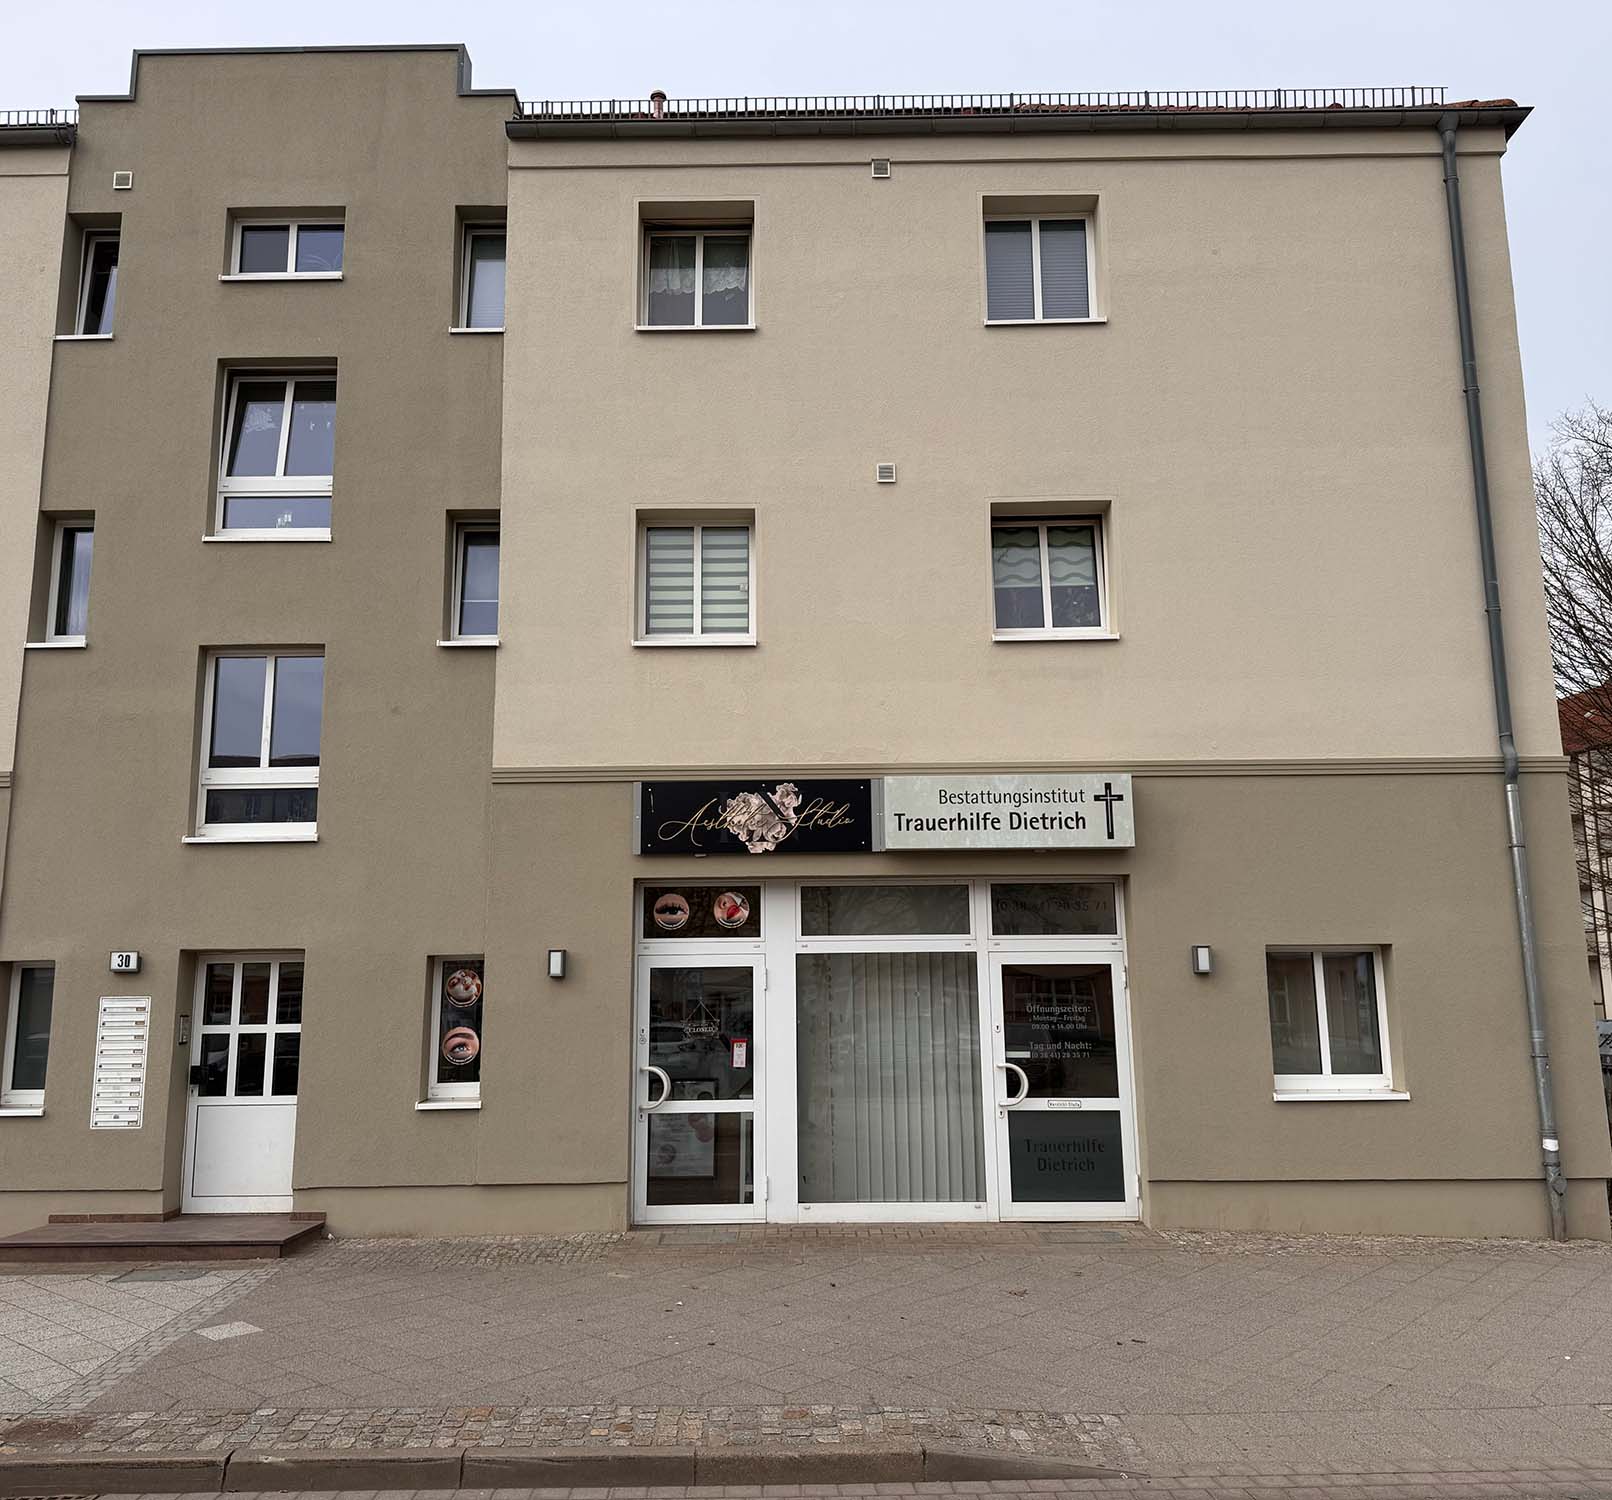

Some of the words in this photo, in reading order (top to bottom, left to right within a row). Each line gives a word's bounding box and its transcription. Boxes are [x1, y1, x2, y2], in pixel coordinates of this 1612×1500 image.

[939, 788, 1086, 808] Bestattungsinstitut
[764, 797, 856, 845] Studio
[893, 812, 1001, 832] Trauerhilfe
[1009, 811, 1087, 830] Dietrich
[117, 954, 131, 968] 30
[1026, 1003, 1091, 1014] Öffnungszeiten:
[1030, 1042, 1044, 1051] Tag
[1046, 1041, 1062, 1050] und
[1064, 1041, 1092, 1050] Nacht:
[1024, 1138, 1105, 1152] Trauerhilfe
[1037, 1157, 1095, 1171] Dietrich
